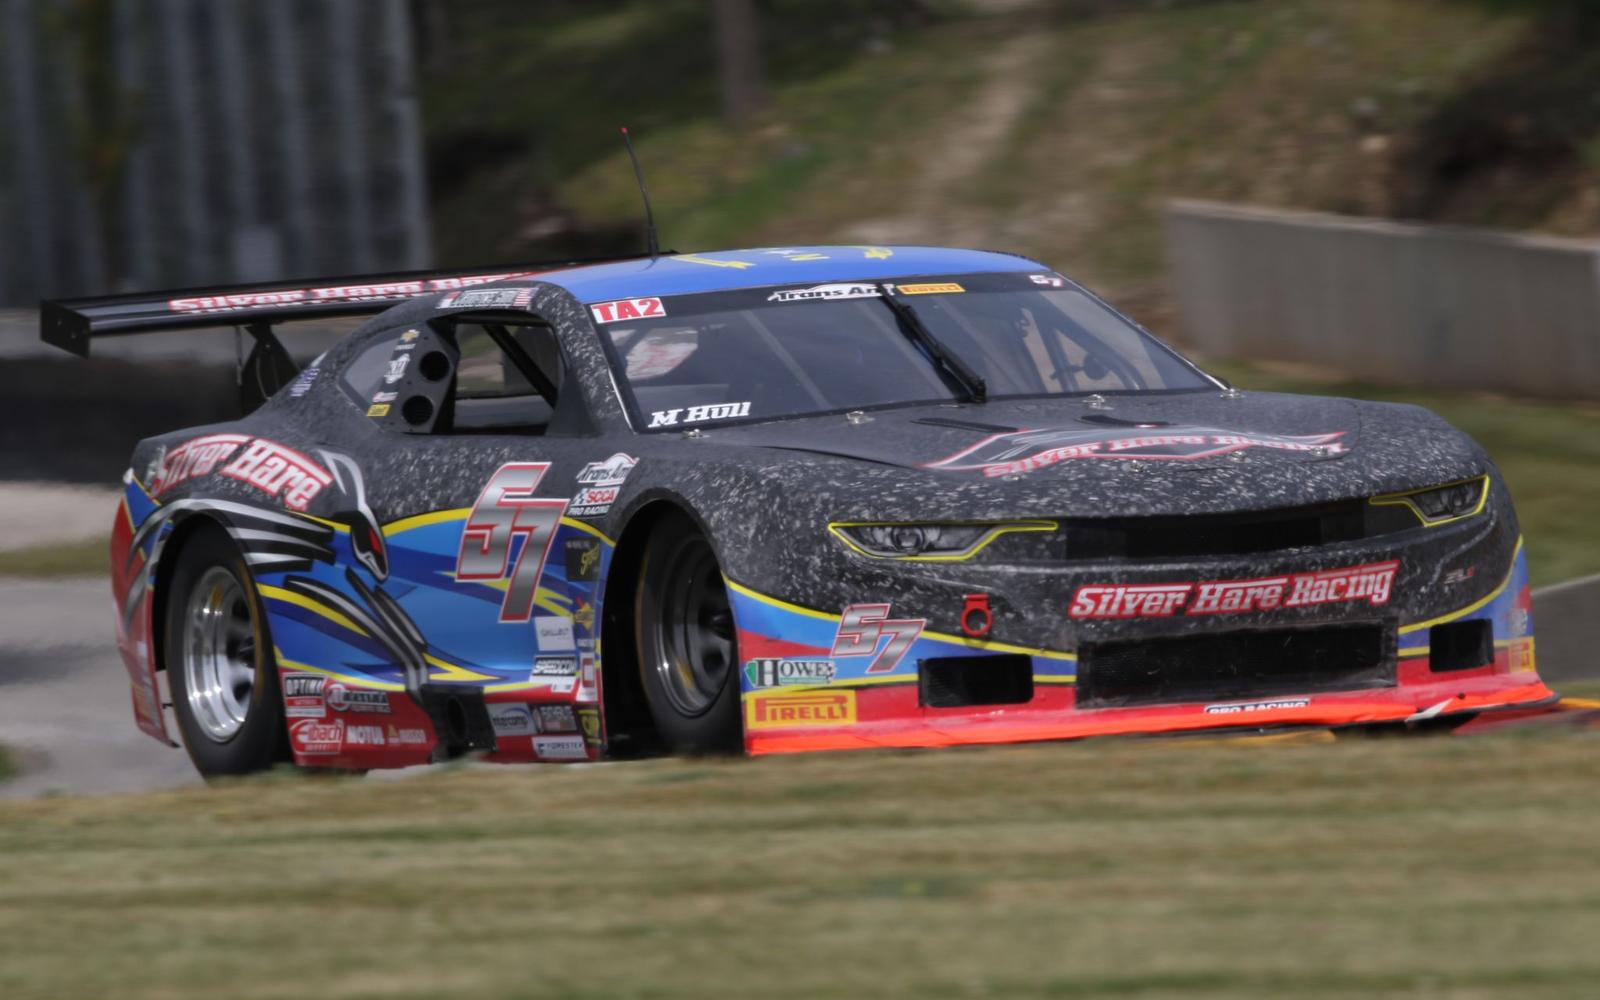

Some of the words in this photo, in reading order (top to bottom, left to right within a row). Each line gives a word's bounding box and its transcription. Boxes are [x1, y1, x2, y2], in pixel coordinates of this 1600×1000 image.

[1029, 274, 1062, 287] 57
[168, 290, 304, 311] Silver
[776, 289, 844, 300] Trans
[592, 299, 664, 321] TA2
[648, 409, 684, 428] M
[683, 402, 751, 422] Hull
[983, 442, 1100, 478] Silver
[1109, 435, 1205, 451] Hare
[150, 434, 252, 499] Silver
[220, 438, 334, 511] Hare
[586, 489, 616, 504] SCCA
[456, 462, 570, 623] 57
[1071, 585, 1192, 616] Silver
[1190, 578, 1288, 612] Hare
[1286, 562, 1398, 604] Racing
[829, 603, 926, 673] 57
[756, 659, 829, 687] HOWE
[755, 695, 848, 722] PIRELLI
[347, 725, 384, 745] MOTUL
